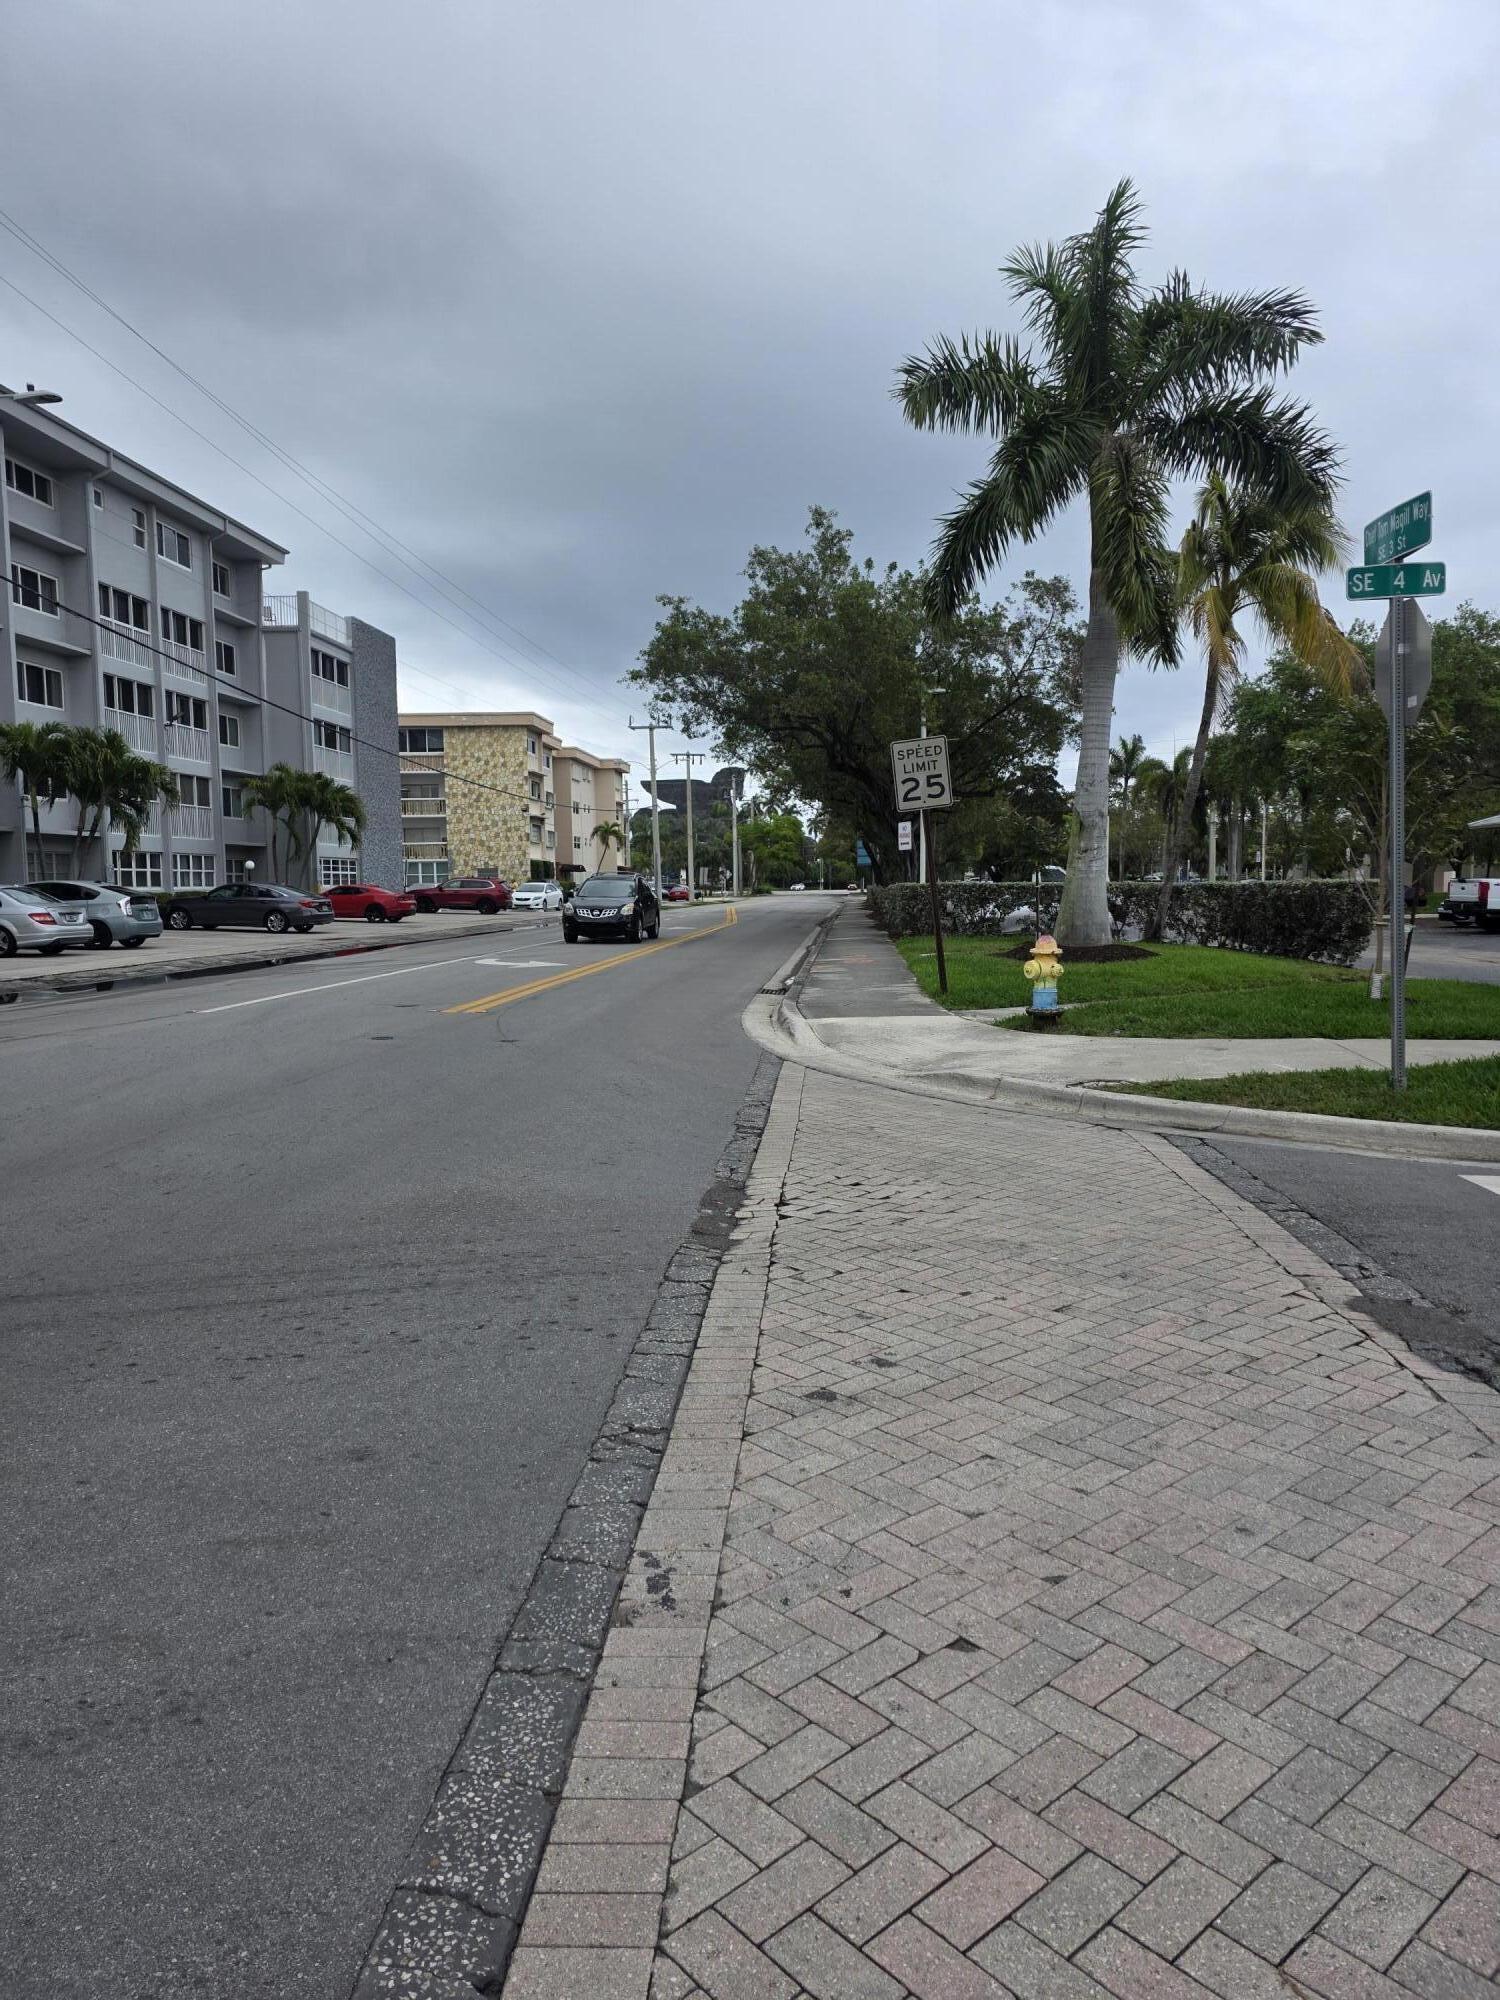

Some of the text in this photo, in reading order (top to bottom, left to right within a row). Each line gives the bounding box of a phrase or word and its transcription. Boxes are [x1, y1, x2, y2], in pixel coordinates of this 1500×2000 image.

[1412, 502, 1428, 521] Way
[1389, 540, 1394, 554] 3
[1397, 535, 1406, 551] St
[1352, 569, 1441, 592] SE 4 Av
[897, 745, 942, 761] SPEED
[903, 760, 938, 774] LIMIT
[901, 773, 945, 802] 25
